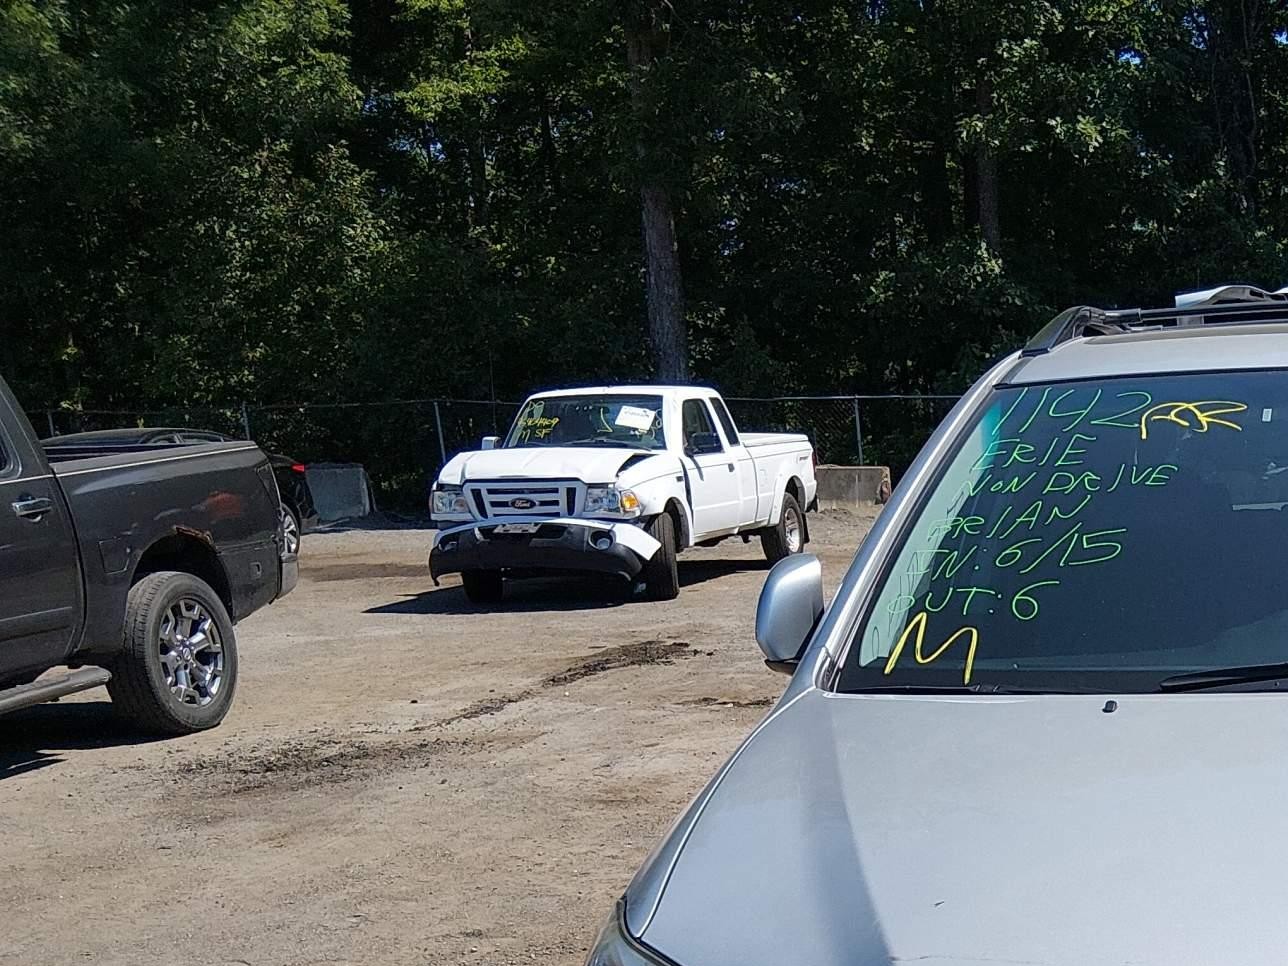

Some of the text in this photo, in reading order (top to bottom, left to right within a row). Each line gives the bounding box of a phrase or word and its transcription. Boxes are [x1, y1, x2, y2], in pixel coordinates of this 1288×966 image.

[991, 386, 1151, 436] 1142
[970, 433, 1097, 473] ERIE
[1042, 463, 1178, 495] DRIVE
[884, 611, 978, 686] M
